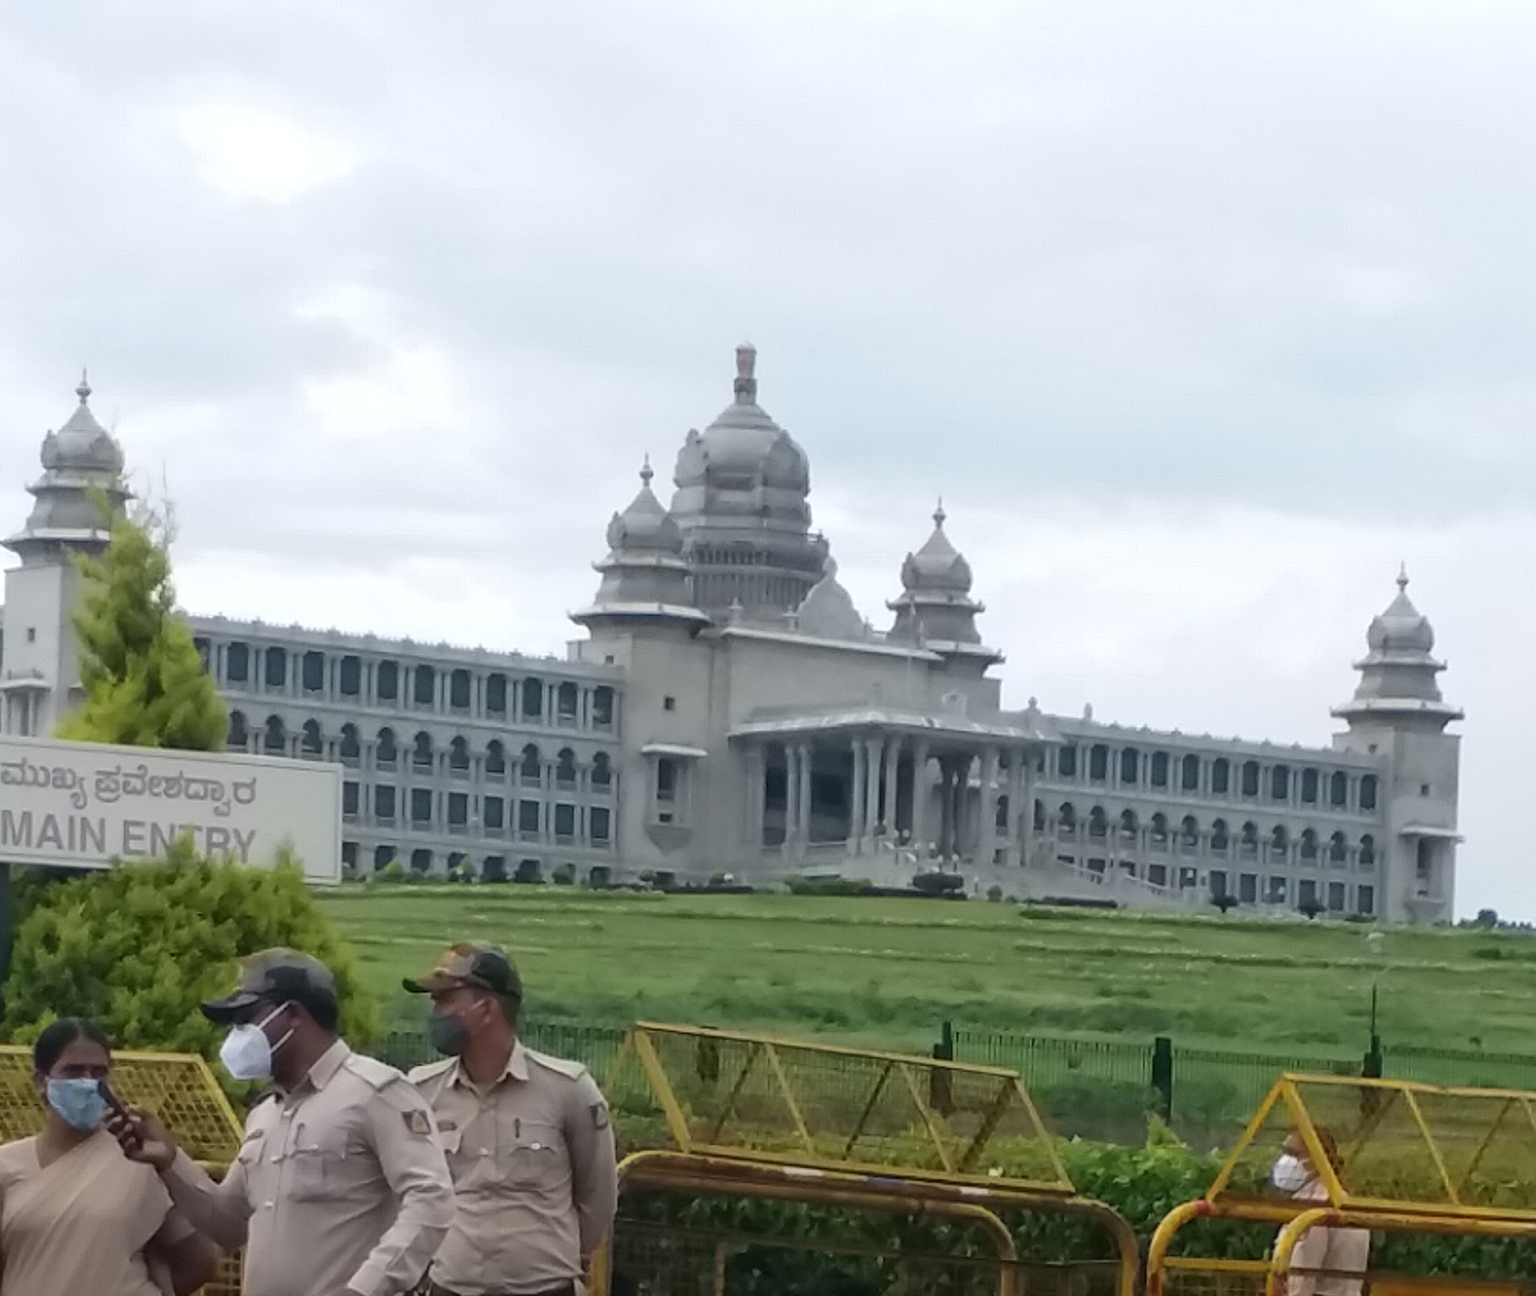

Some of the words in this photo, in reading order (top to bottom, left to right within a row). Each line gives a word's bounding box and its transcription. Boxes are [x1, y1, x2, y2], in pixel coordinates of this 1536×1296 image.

[0, 758, 87, 810] ಮುಖ್ಯ
[95, 764, 257, 817] ಪ್ರವೇಶದ್ವಾರ
[1, 810, 106, 853] MAIN
